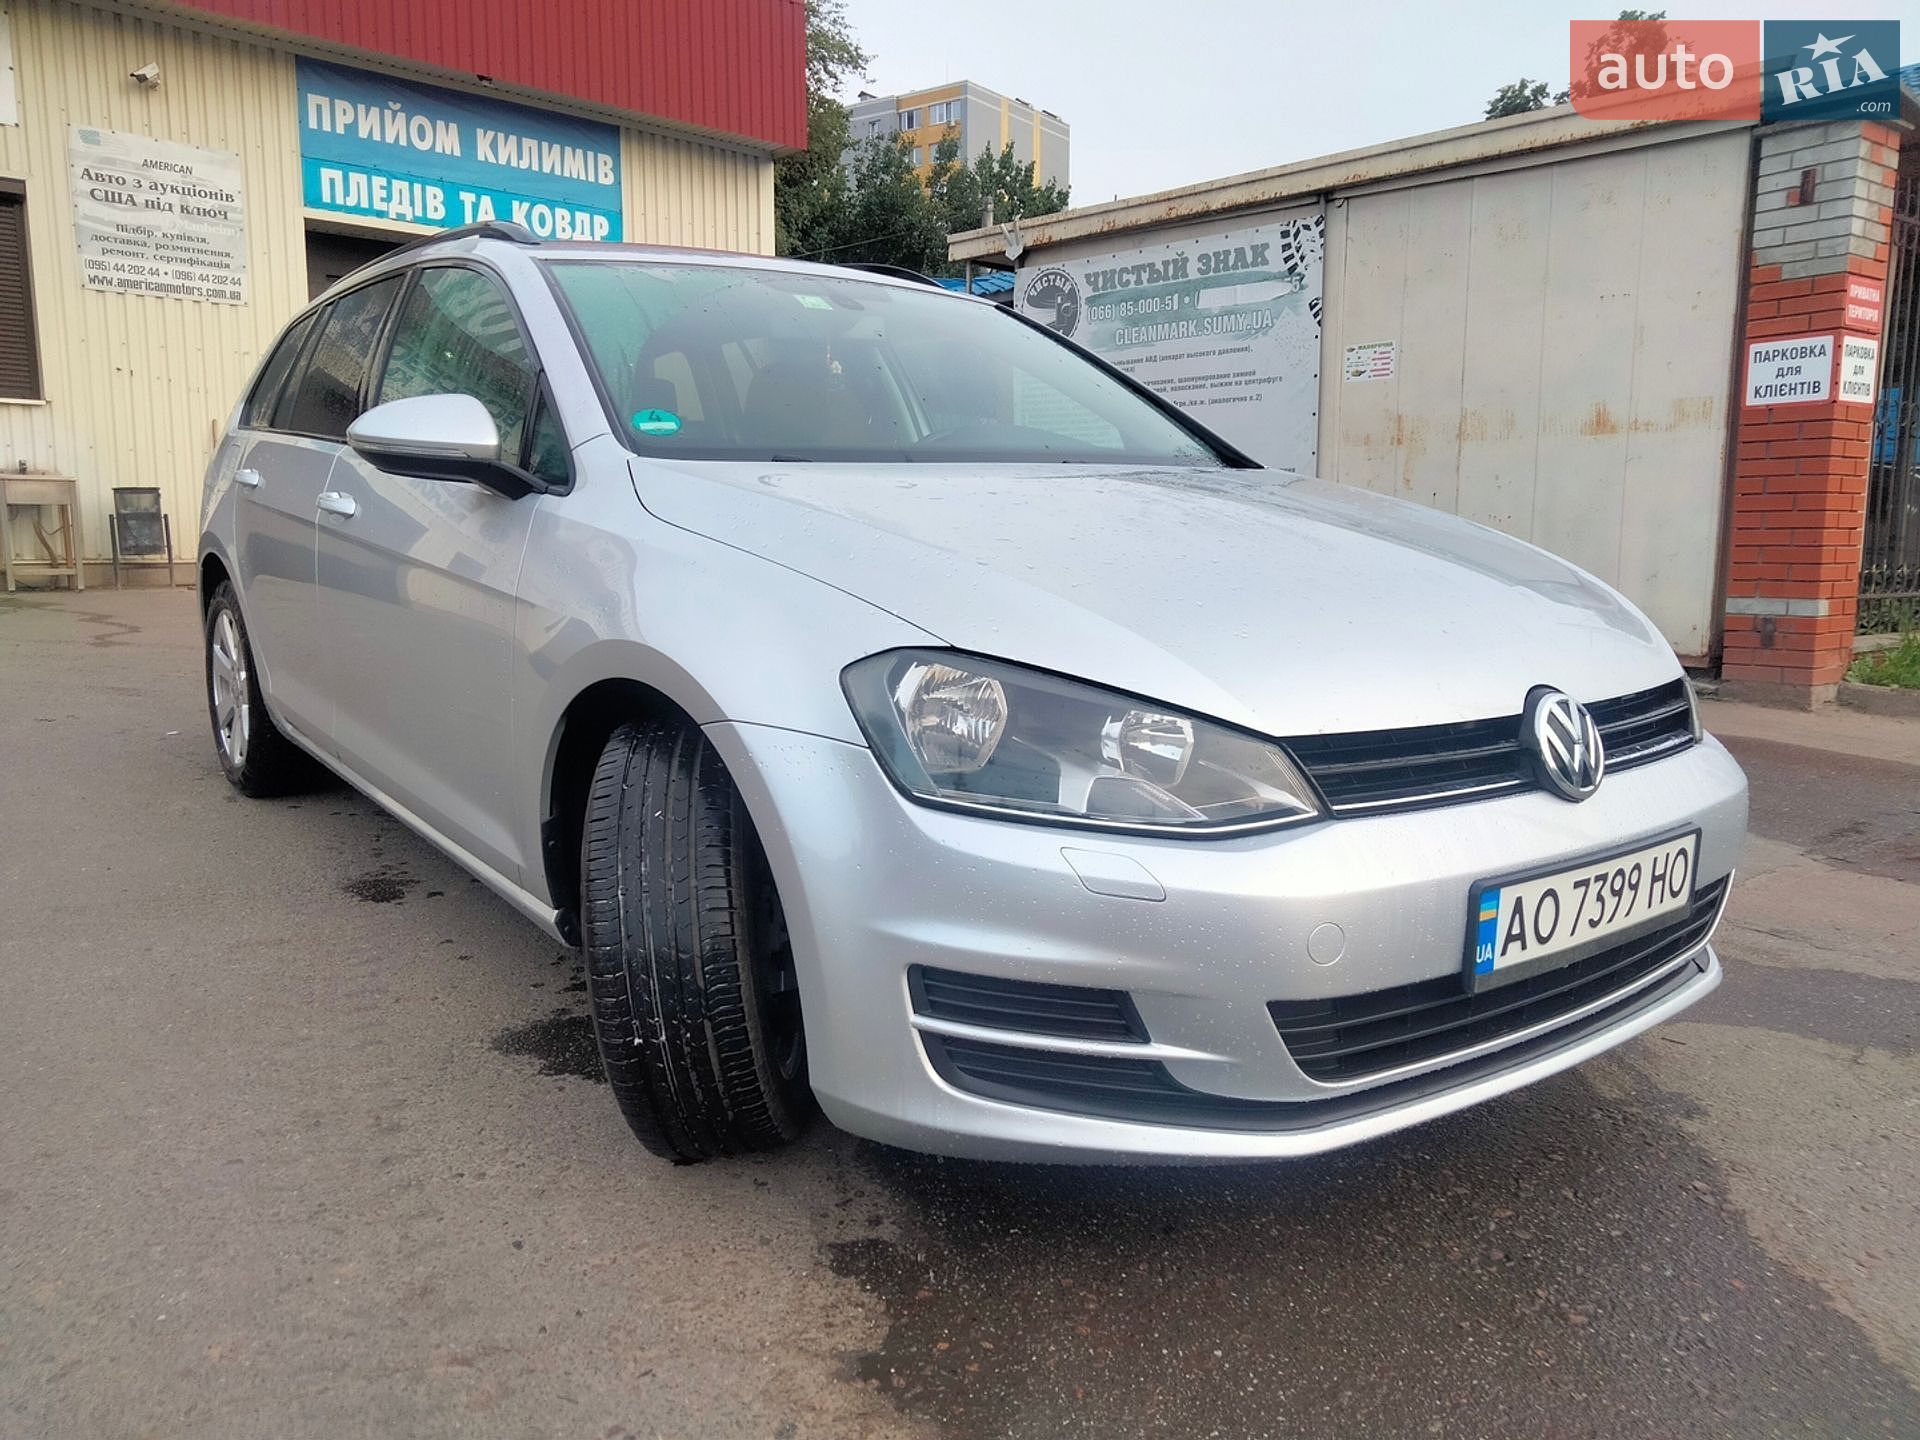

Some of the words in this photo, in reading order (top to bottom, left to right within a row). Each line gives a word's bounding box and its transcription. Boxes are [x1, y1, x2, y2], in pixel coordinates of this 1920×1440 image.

[306, 93, 461, 157] ПРИЙОМ
[476, 128, 615, 185] КИЛИМІВ
[142, 158, 193, 175] AMERICAN
[81, 168, 127, 186] Авто
[133, 179, 142, 189] з
[149, 181, 235, 203] аукціонів
[89, 188, 137, 207] США
[144, 197, 173, 214] під
[180, 203, 228, 220] ключ
[320, 167, 446, 222] ПЛЕДІВ
[459, 192, 496, 223] ТА
[512, 201, 609, 241] КОВДР
[91, 234, 151, 248] доставка,
[84, 258, 111, 272] (095)
[172, 269, 196, 282] (096)
[1085, 251, 1190, 293] ЧИСТЫЙ
[1196, 242, 1270, 275] ЗНАК
[88, 274, 242, 301] www.americanmotors.com.ua
[1087, 303, 1116, 320] (066)
[1116, 310, 1273, 346] CLEANMARK.SUMY.UA
[1753, 344, 1827, 364] ПАРКОВКА
[1845, 343, 1875, 361] ПАРКОВКА
[1754, 381, 1821, 399] КЛІЄНТІВ
[1569, 862, 1642, 937] 7399
[1476, 944, 1493, 963] UA
